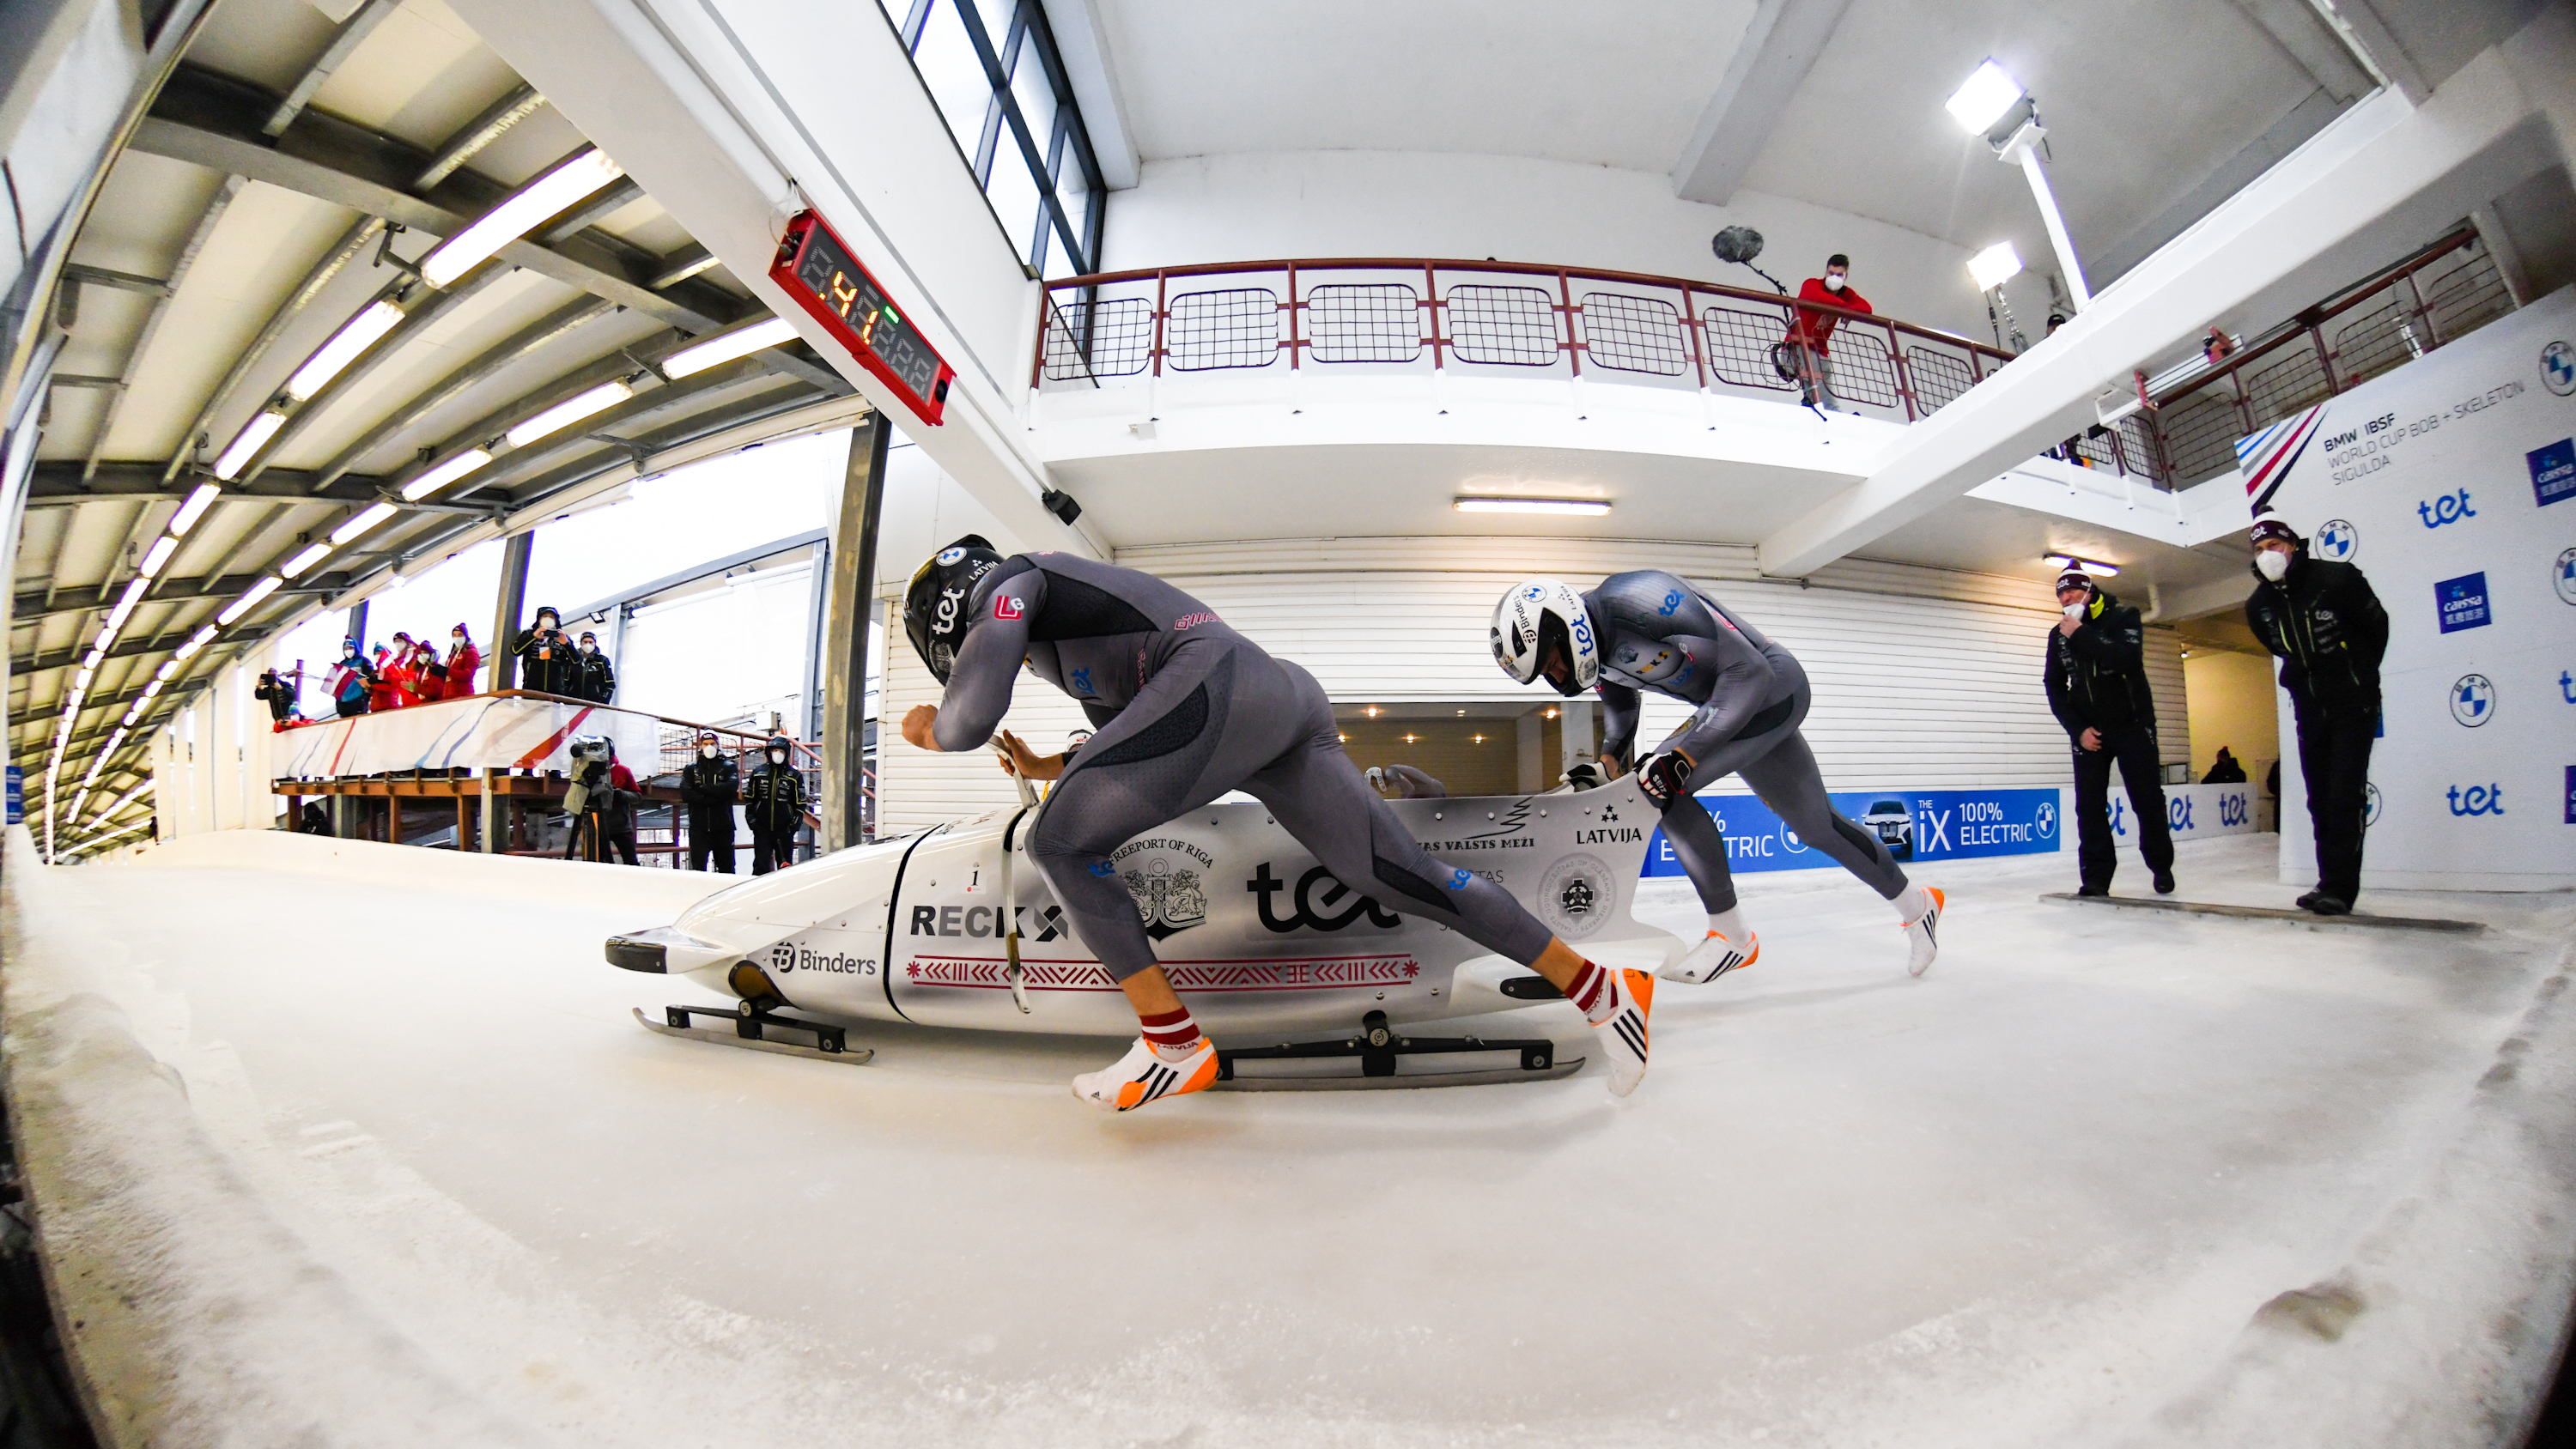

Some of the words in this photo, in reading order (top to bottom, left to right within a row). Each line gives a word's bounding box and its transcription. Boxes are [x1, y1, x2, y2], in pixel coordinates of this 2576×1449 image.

[2324, 428, 2358, 452] BMW
[2364, 412, 2397, 436] IBSF
[2327, 440, 2378, 469] WORLD
[2379, 427, 2408, 449] CUP
[2409, 415, 2440, 438] BOB
[2453, 379, 2526, 419] SKELETON
[2331, 454, 2391, 486] SIGULDA
[2417, 487, 2477, 530] tet
[968, 560, 999, 582] LATVIJA
[932, 587, 966, 635] tet
[1512, 595, 1531, 630] Binders
[1559, 585, 1577, 610] LATVIJA
[1658, 588, 1687, 617] tet
[1570, 613, 1595, 657] tet
[1652, 773, 1668, 793] SEIZ
[1917, 799, 1933, 809] THE
[1959, 802, 2003, 822] 100%
[2219, 791, 2249, 827] tet
[2445, 782, 2506, 816] tet
[1444, 839, 1497, 851] VALSTS
[1500, 835, 1535, 849] MEŽI
[1576, 827, 1643, 845] LATVIJA
[1919, 809, 1952, 853] iX
[1960, 822, 2033, 846] ELECTRIC
[1109, 839, 1167, 867] FREEPORT
[1169, 839, 1185, 851] OF
[1185, 843, 1213, 869] RIGA
[910, 905, 1027, 939] RECK
[800, 949, 876, 975] Binders
[1157, 1040, 1200, 1052] LATVIJA
